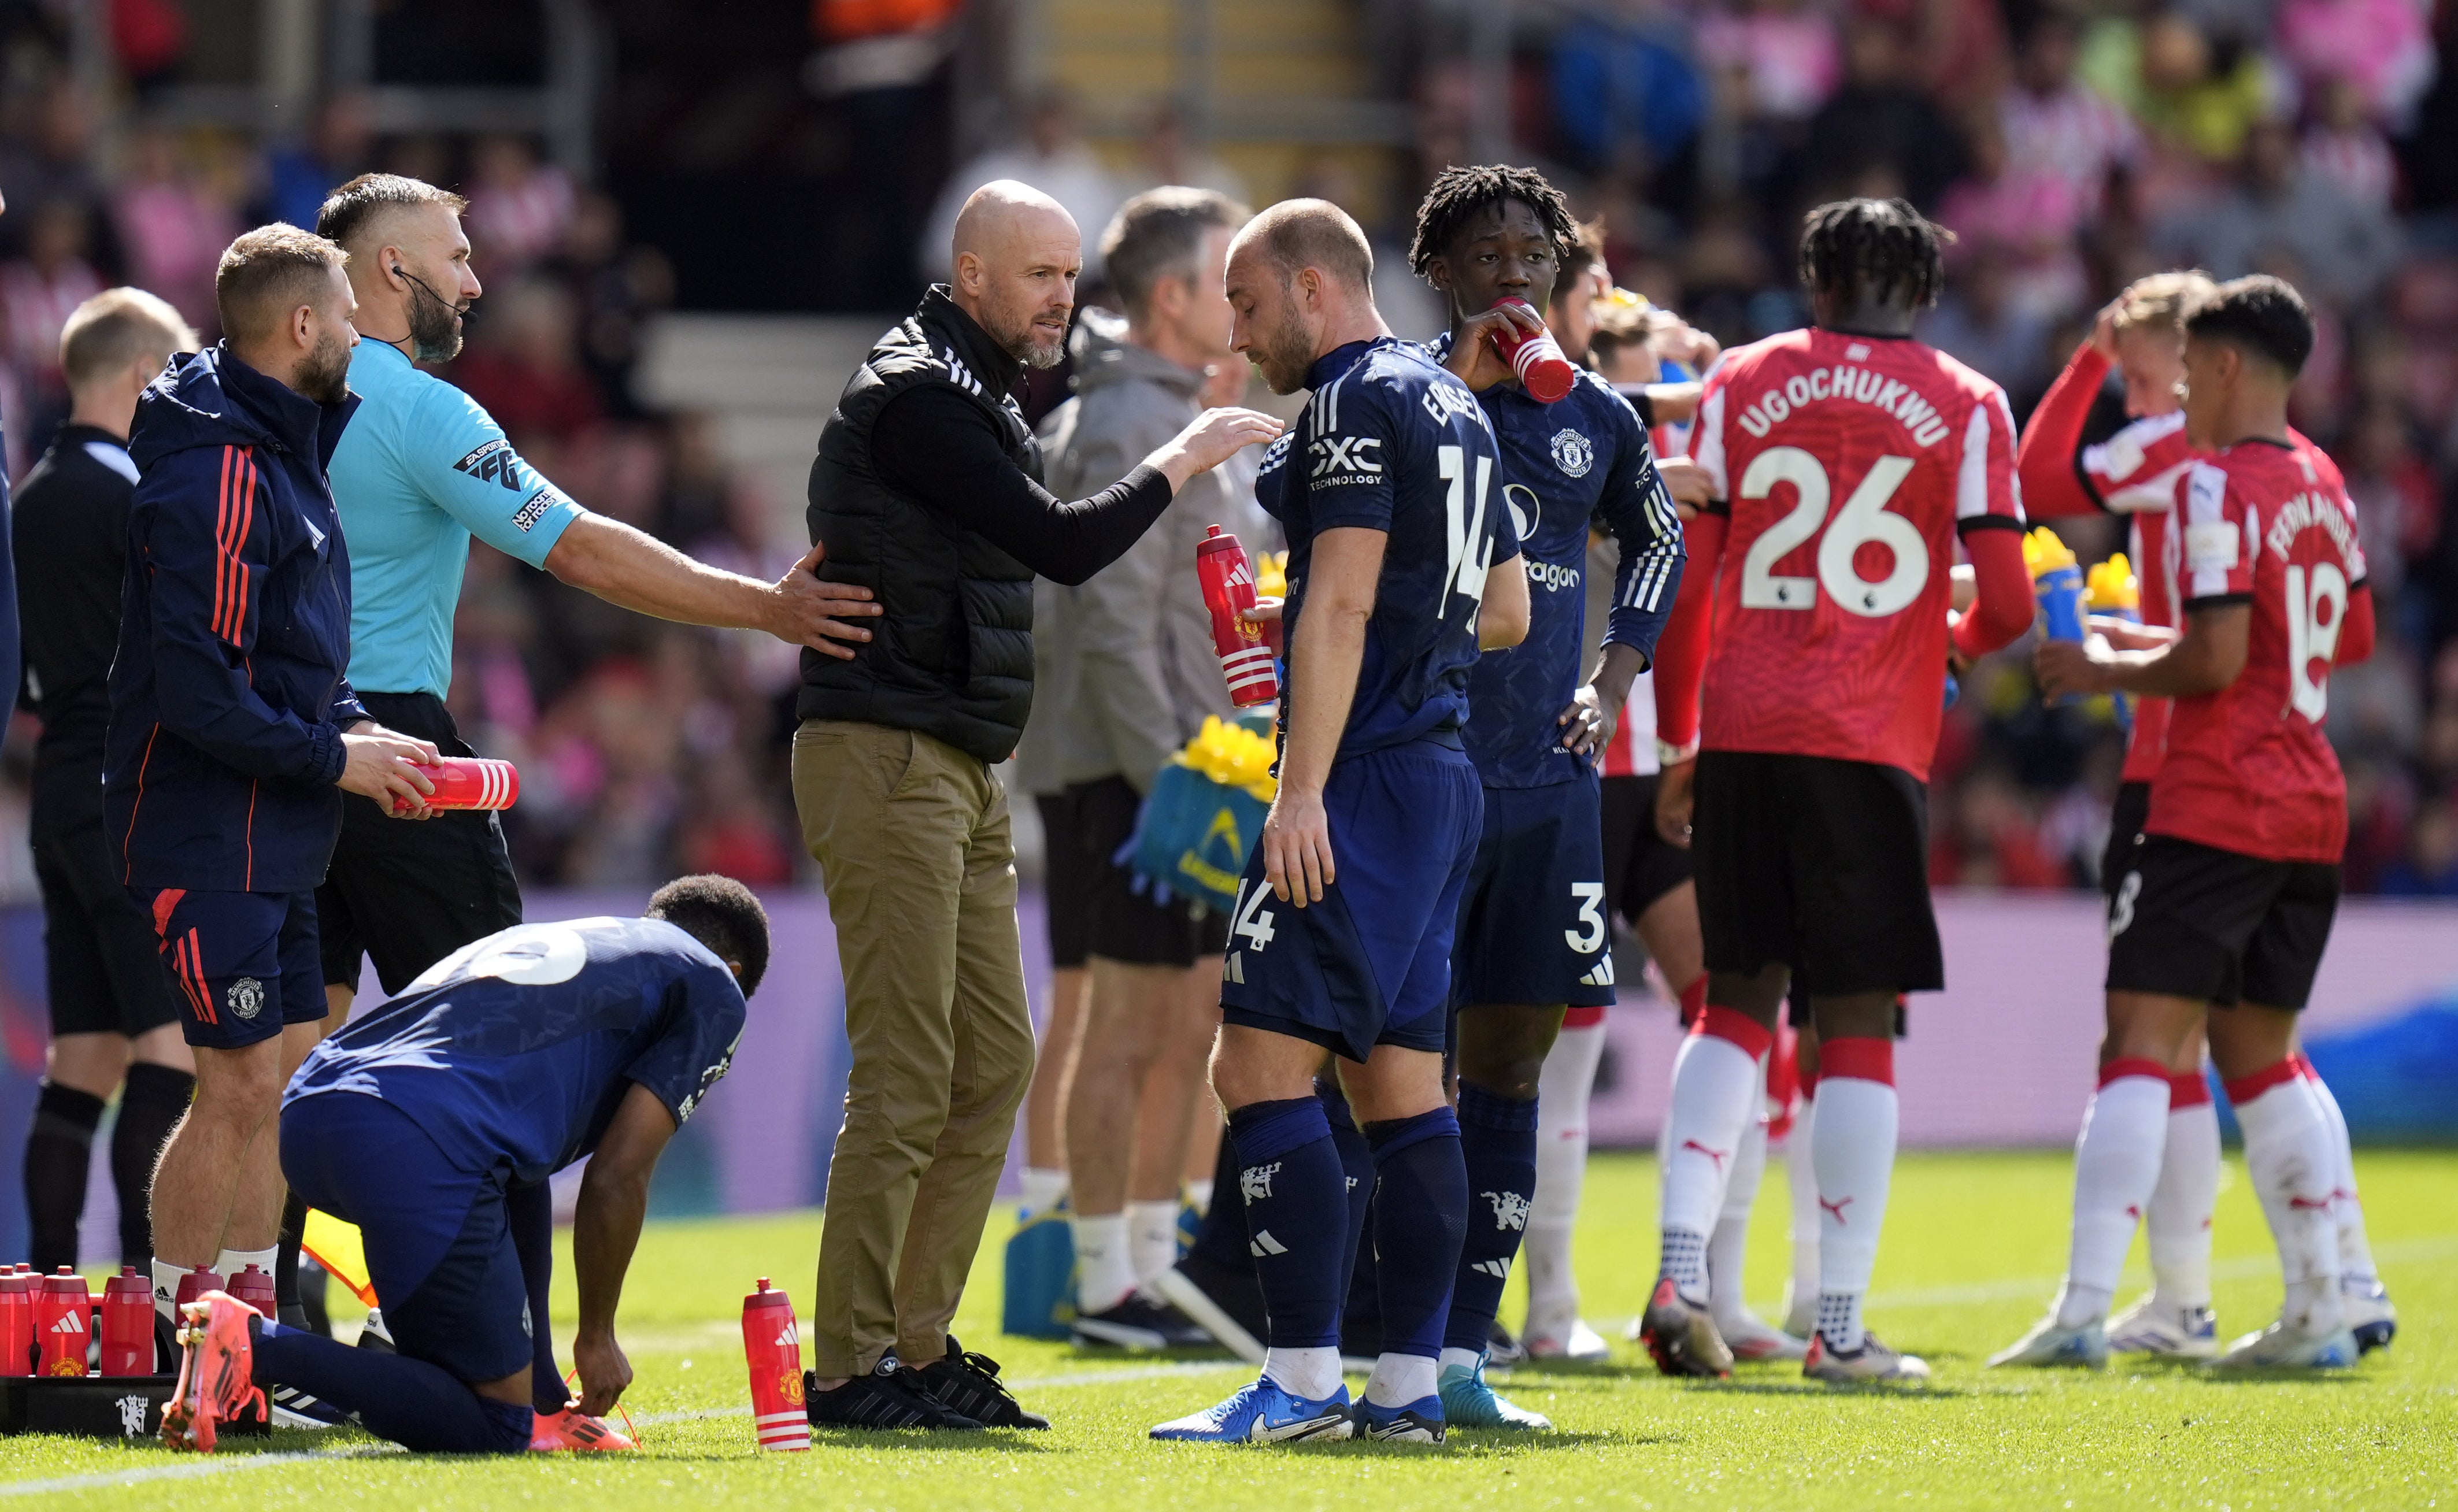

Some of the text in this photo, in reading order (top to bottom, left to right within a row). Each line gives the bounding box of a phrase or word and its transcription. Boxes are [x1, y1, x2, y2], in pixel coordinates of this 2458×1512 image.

[1422, 380, 1490, 433] ERSEN
[1738, 365, 1950, 447] UGOCHUKWU
[1554, 432, 1588, 449] MANCHESTER
[465, 453, 480, 466] EA
[1563, 465, 1586, 474] UNITED
[1310, 475, 1382, 491] TECHNOLOGY
[512, 511, 528, 528] No
[520, 516, 535, 533] for
[1741, 445, 1930, 618] 26
[1437, 446, 1494, 635] 14
[1225, 877, 1275, 952] 14
[231, 980, 260, 996] MANCHESTER
[239, 1006, 259, 1016] UNITED
